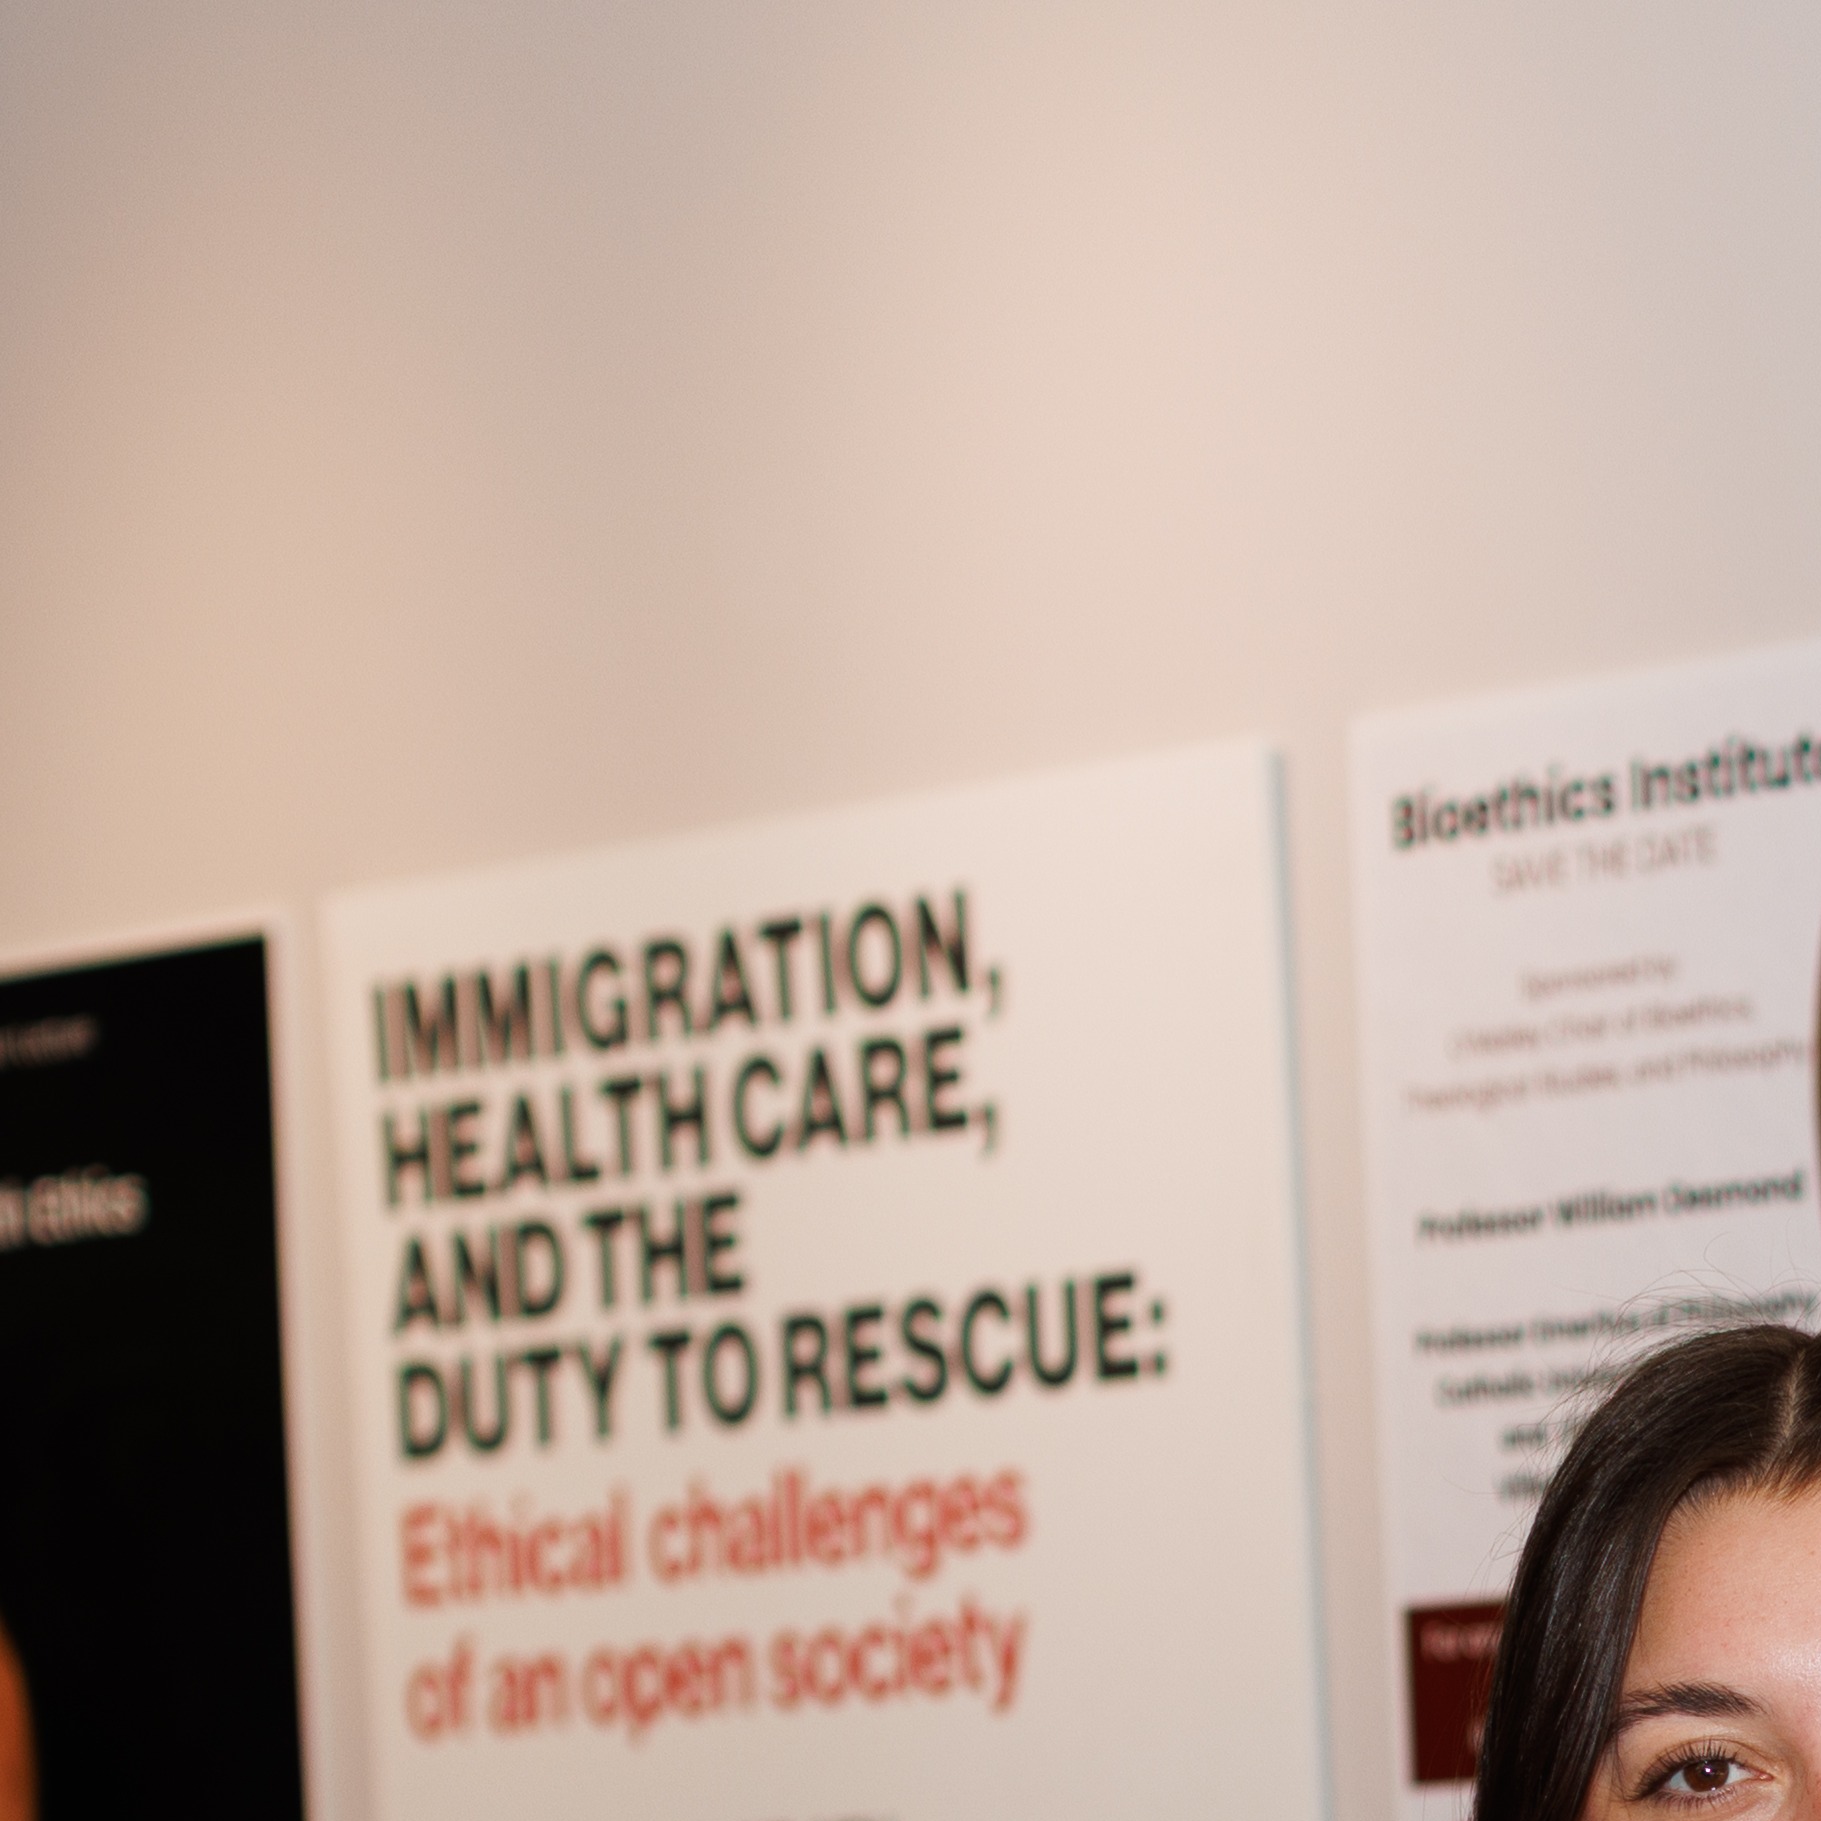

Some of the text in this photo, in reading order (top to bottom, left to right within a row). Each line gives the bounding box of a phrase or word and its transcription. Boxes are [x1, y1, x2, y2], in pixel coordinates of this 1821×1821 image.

[1393, 759, 1615, 852] Bioethics
[373, 889, 1005, 1085] IMMIGRATION,
[382, 1026, 998, 1206] HEALTH CARE,
[395, 1193, 748, 1334] AND THE
[400, 1268, 1168, 1462] DUTY TO RESCUE:
[398, 1465, 1027, 1608] Ethical challenges
[408, 1596, 1025, 1752] of an open society
